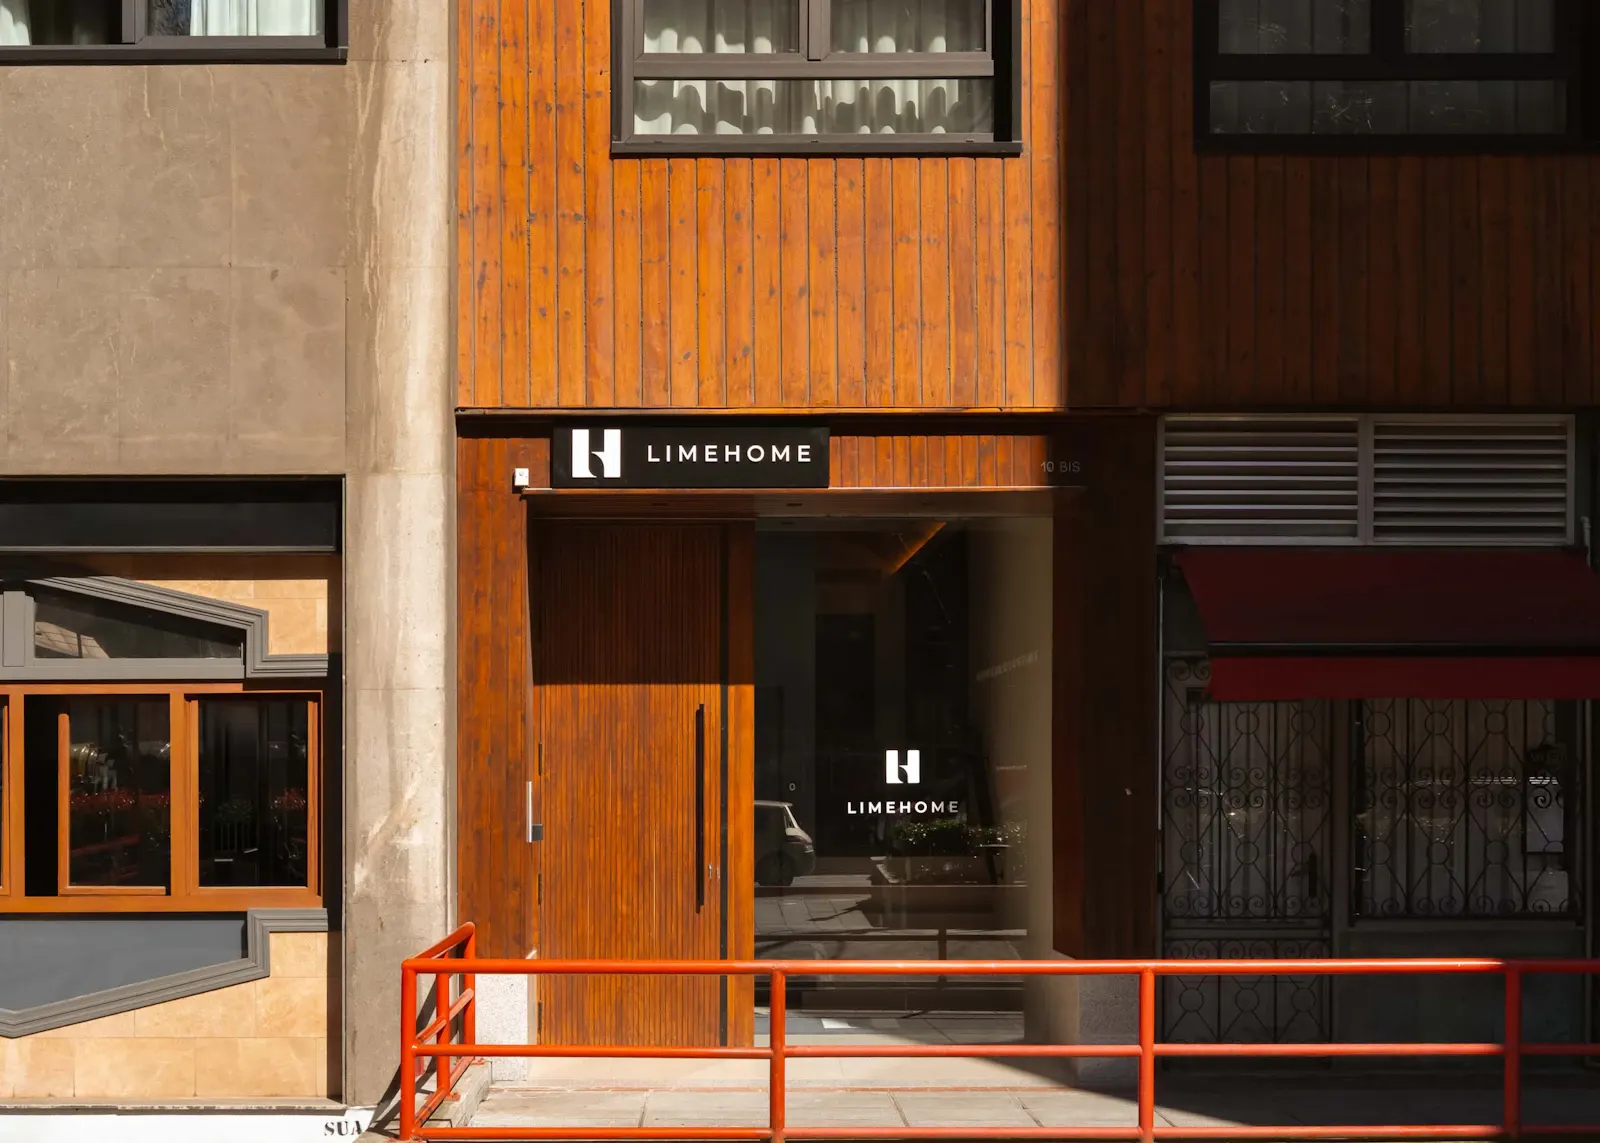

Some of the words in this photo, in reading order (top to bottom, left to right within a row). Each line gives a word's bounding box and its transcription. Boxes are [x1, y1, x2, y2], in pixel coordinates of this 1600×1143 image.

[647, 444, 811, 463] LIMEHOME
[1040, 461, 1054, 473] 10
[1060, 461, 1081, 473] BIS
[847, 801, 959, 814] LIMEHOME
[324, 1120, 362, 1136] SUA
